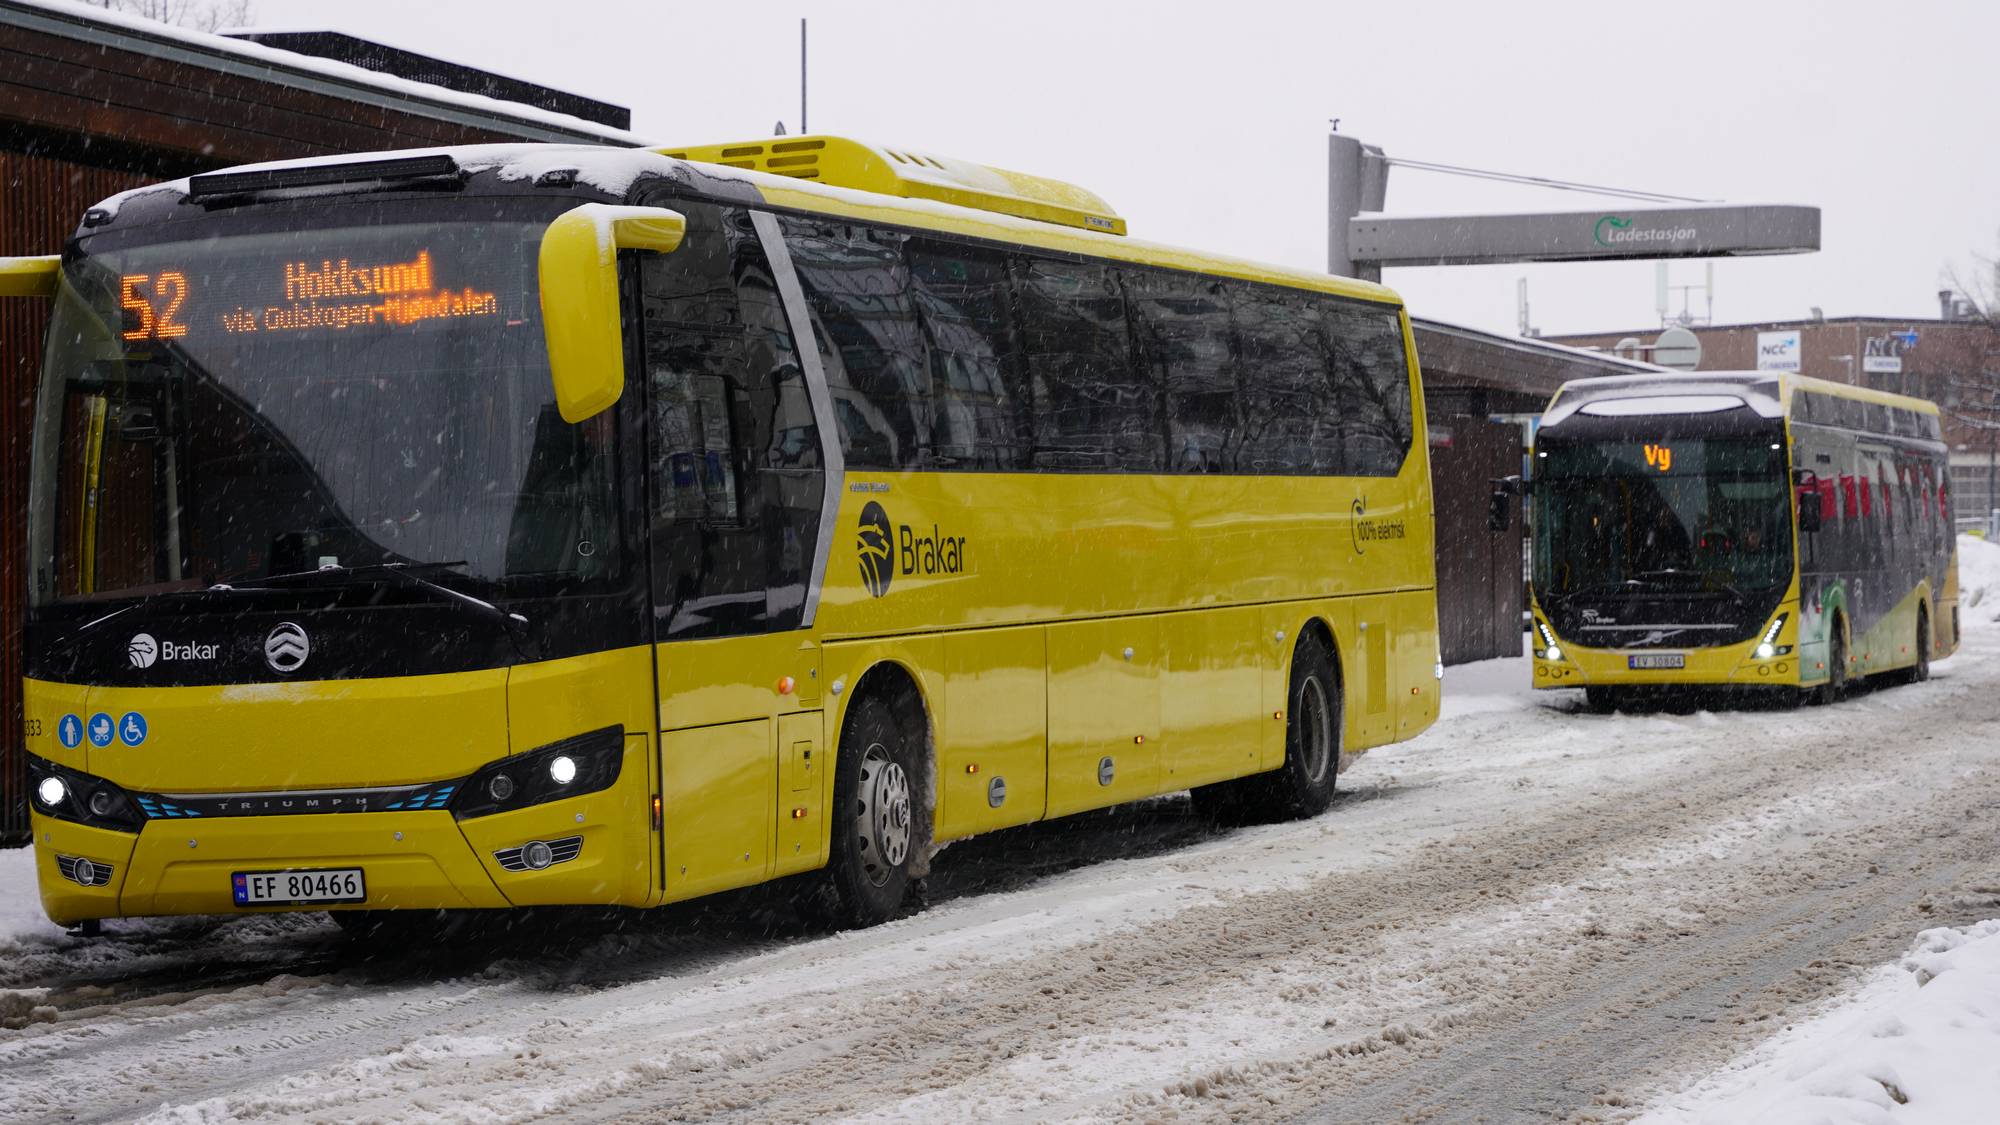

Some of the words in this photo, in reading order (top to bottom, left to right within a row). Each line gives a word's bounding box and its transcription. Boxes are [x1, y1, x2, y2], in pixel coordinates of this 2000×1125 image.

[1607, 226, 1697, 243] Ladestasjon
[286, 250, 433, 299] Hokksund
[122, 271, 187, 340] 52
[223, 306, 258, 332] via
[1761, 345, 1787, 355] NCC
[1643, 444, 1671, 472] Vy
[1357, 521, 1376, 541] 100%
[899, 523, 966, 575] Brakar
[162, 640, 220, 661] Brakar
[218, 797, 367, 810] TRIUMPH
[253, 876, 276, 899] EF
[288, 873, 357, 898] 80466
